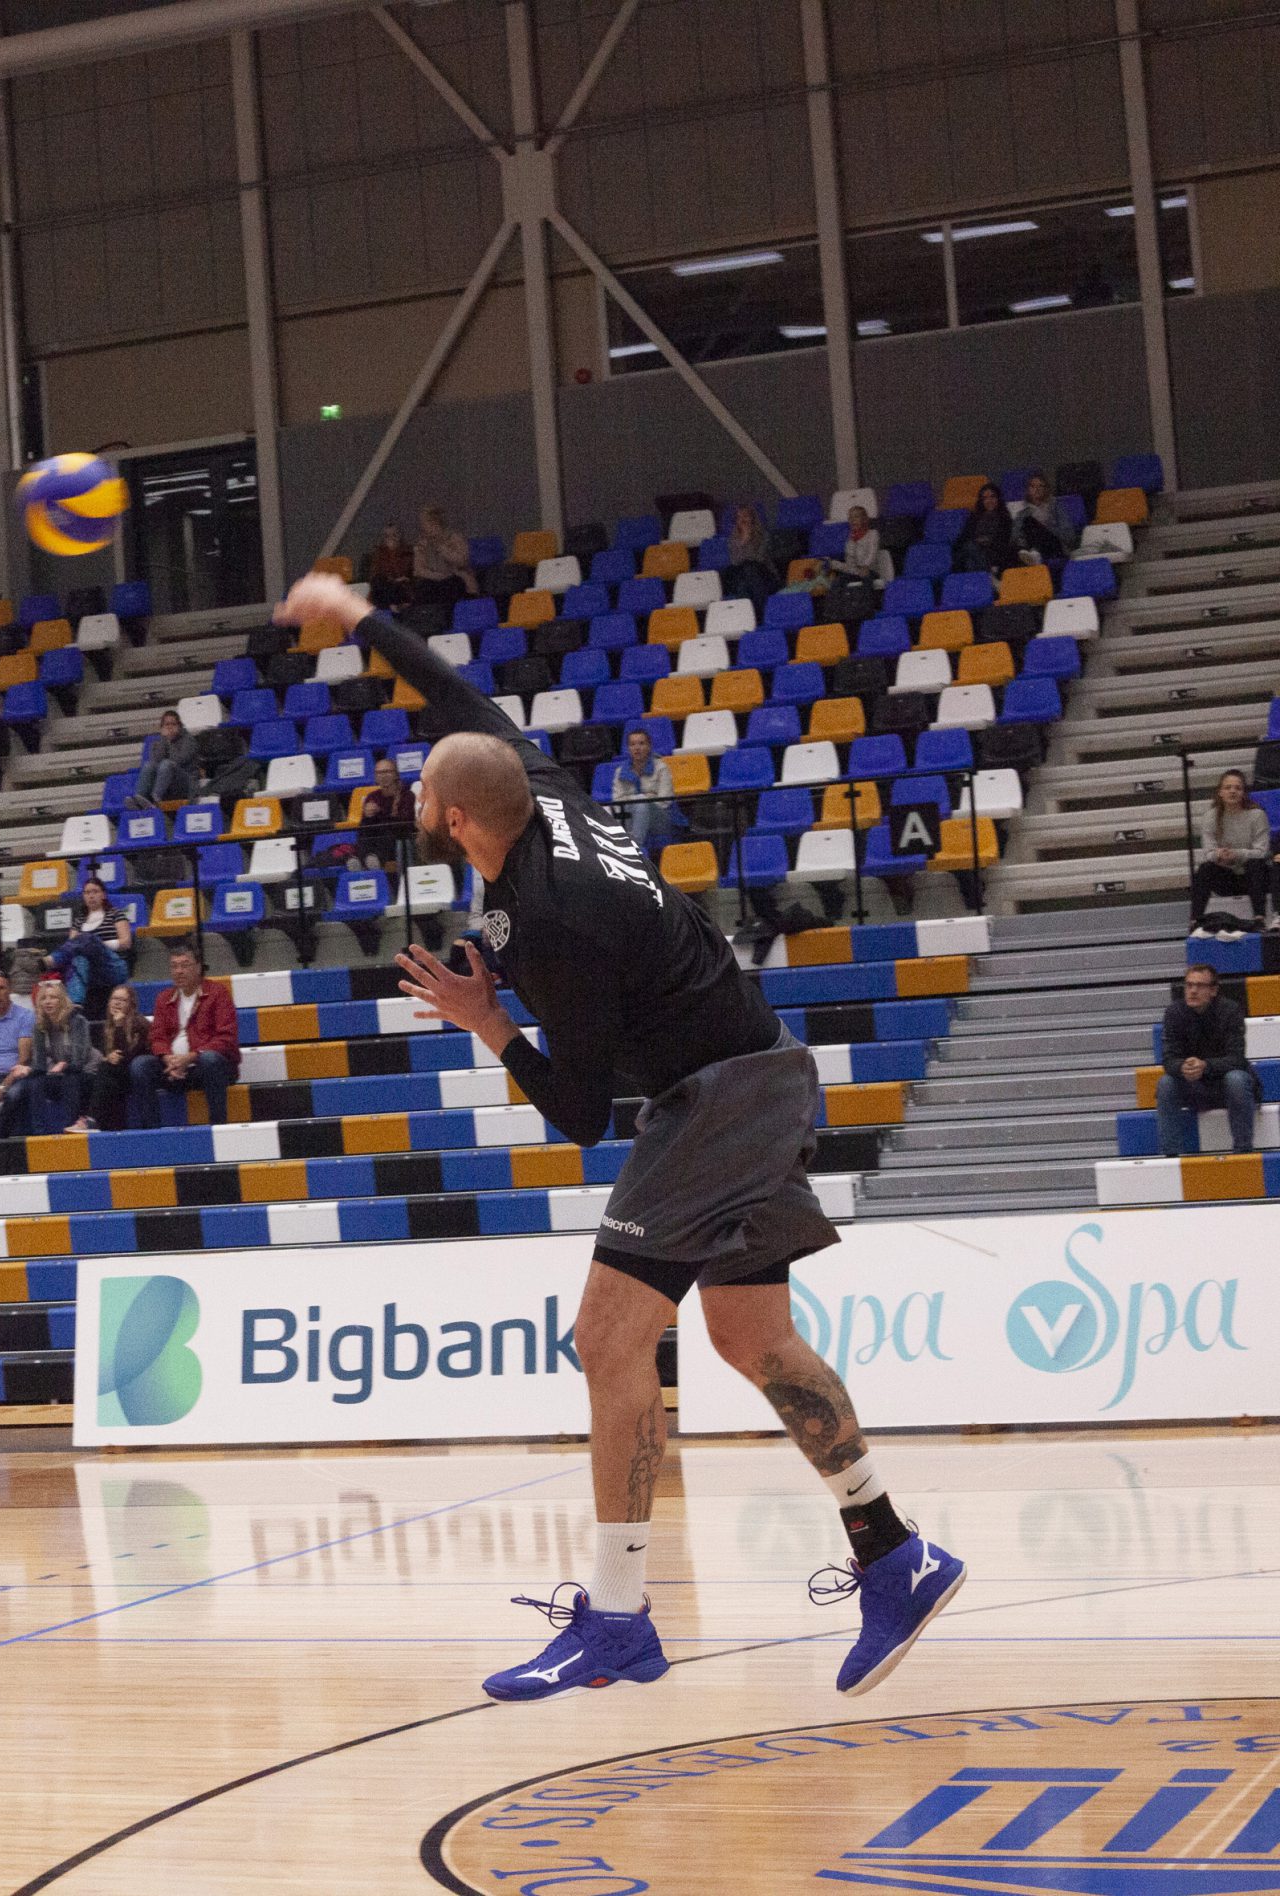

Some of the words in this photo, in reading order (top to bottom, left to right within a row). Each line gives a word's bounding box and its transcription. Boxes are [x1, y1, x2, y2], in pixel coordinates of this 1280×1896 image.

[899, 811, 934, 848] A
[240, 1295, 584, 1405] Bigbank
[1062, 1222, 1249, 1412] Spa
